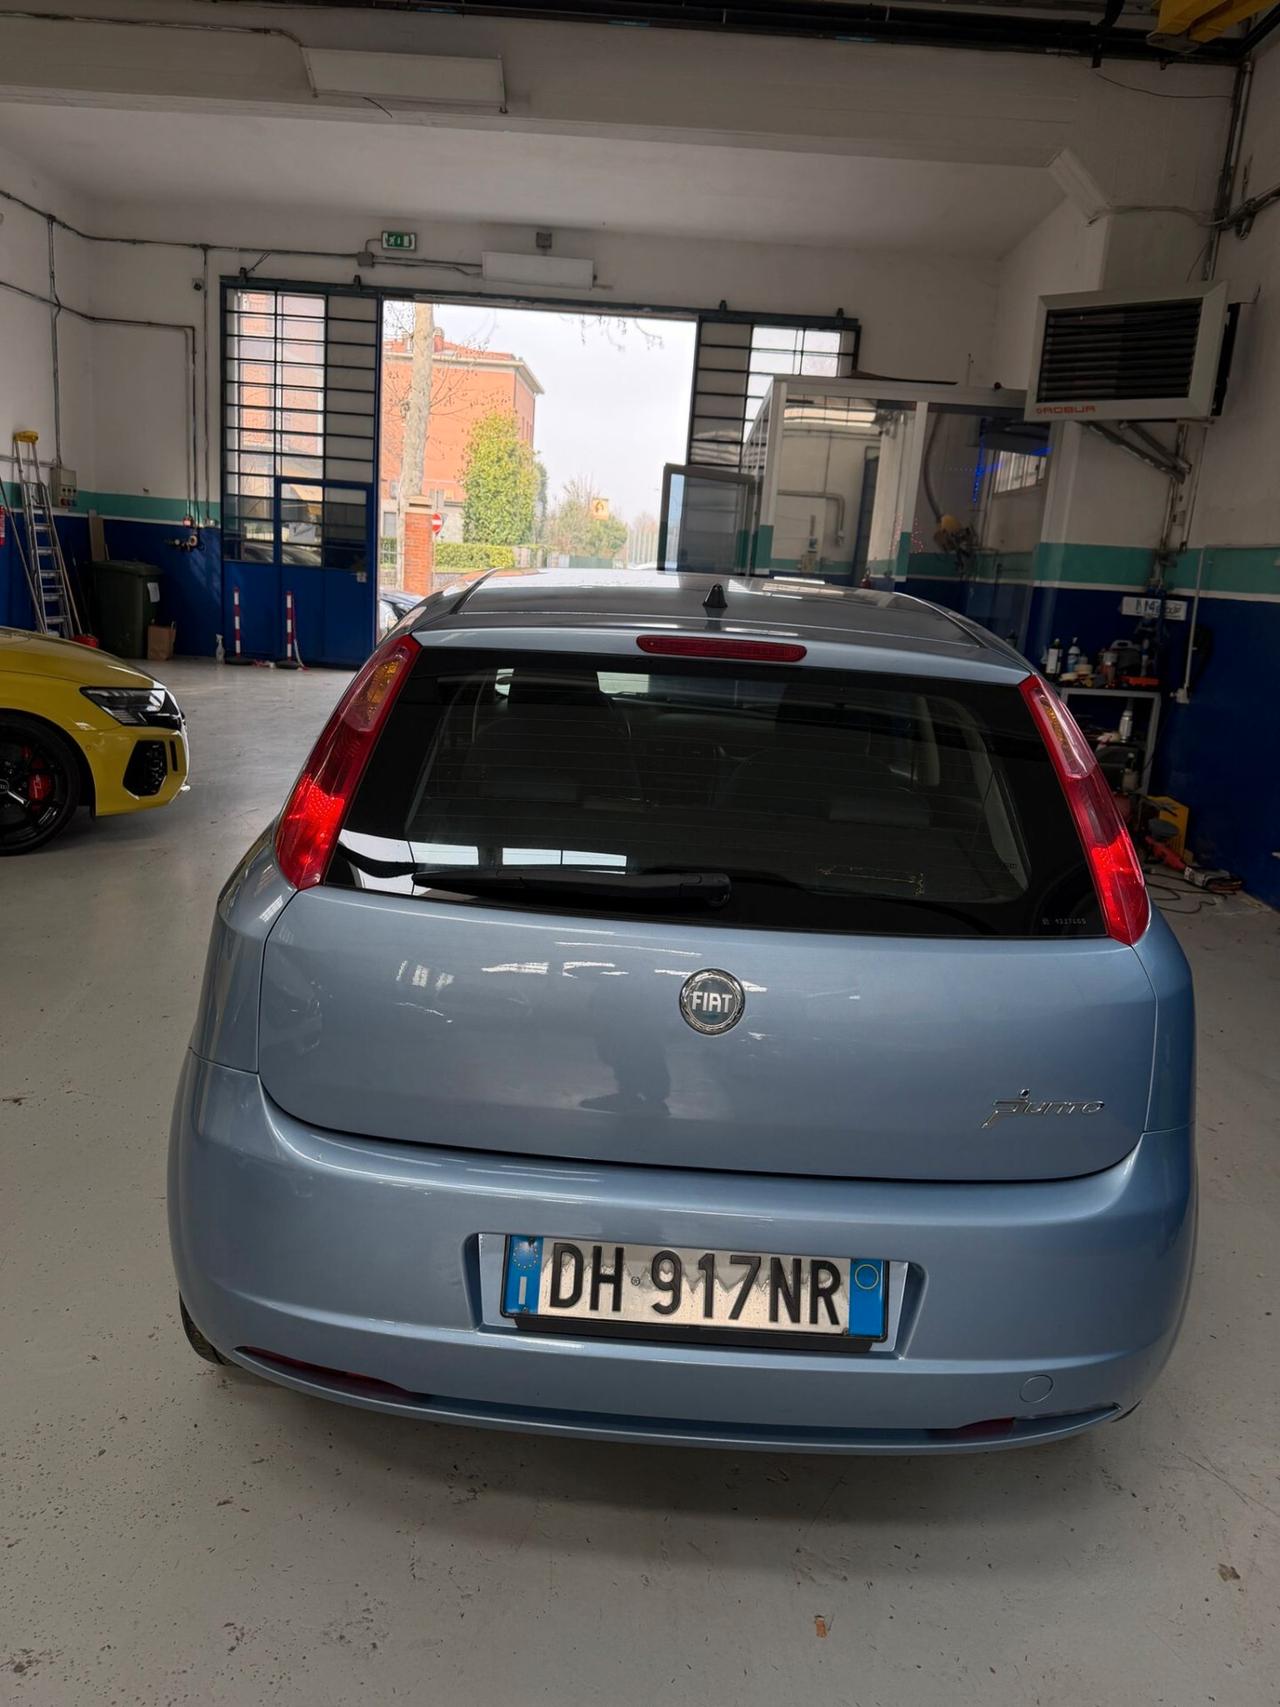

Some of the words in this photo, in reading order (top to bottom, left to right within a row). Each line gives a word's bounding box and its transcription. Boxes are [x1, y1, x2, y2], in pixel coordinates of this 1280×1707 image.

[690, 991, 732, 1013] FIAT
[549, 1242, 625, 1312] DH
[651, 1249, 841, 1325] 917NR
